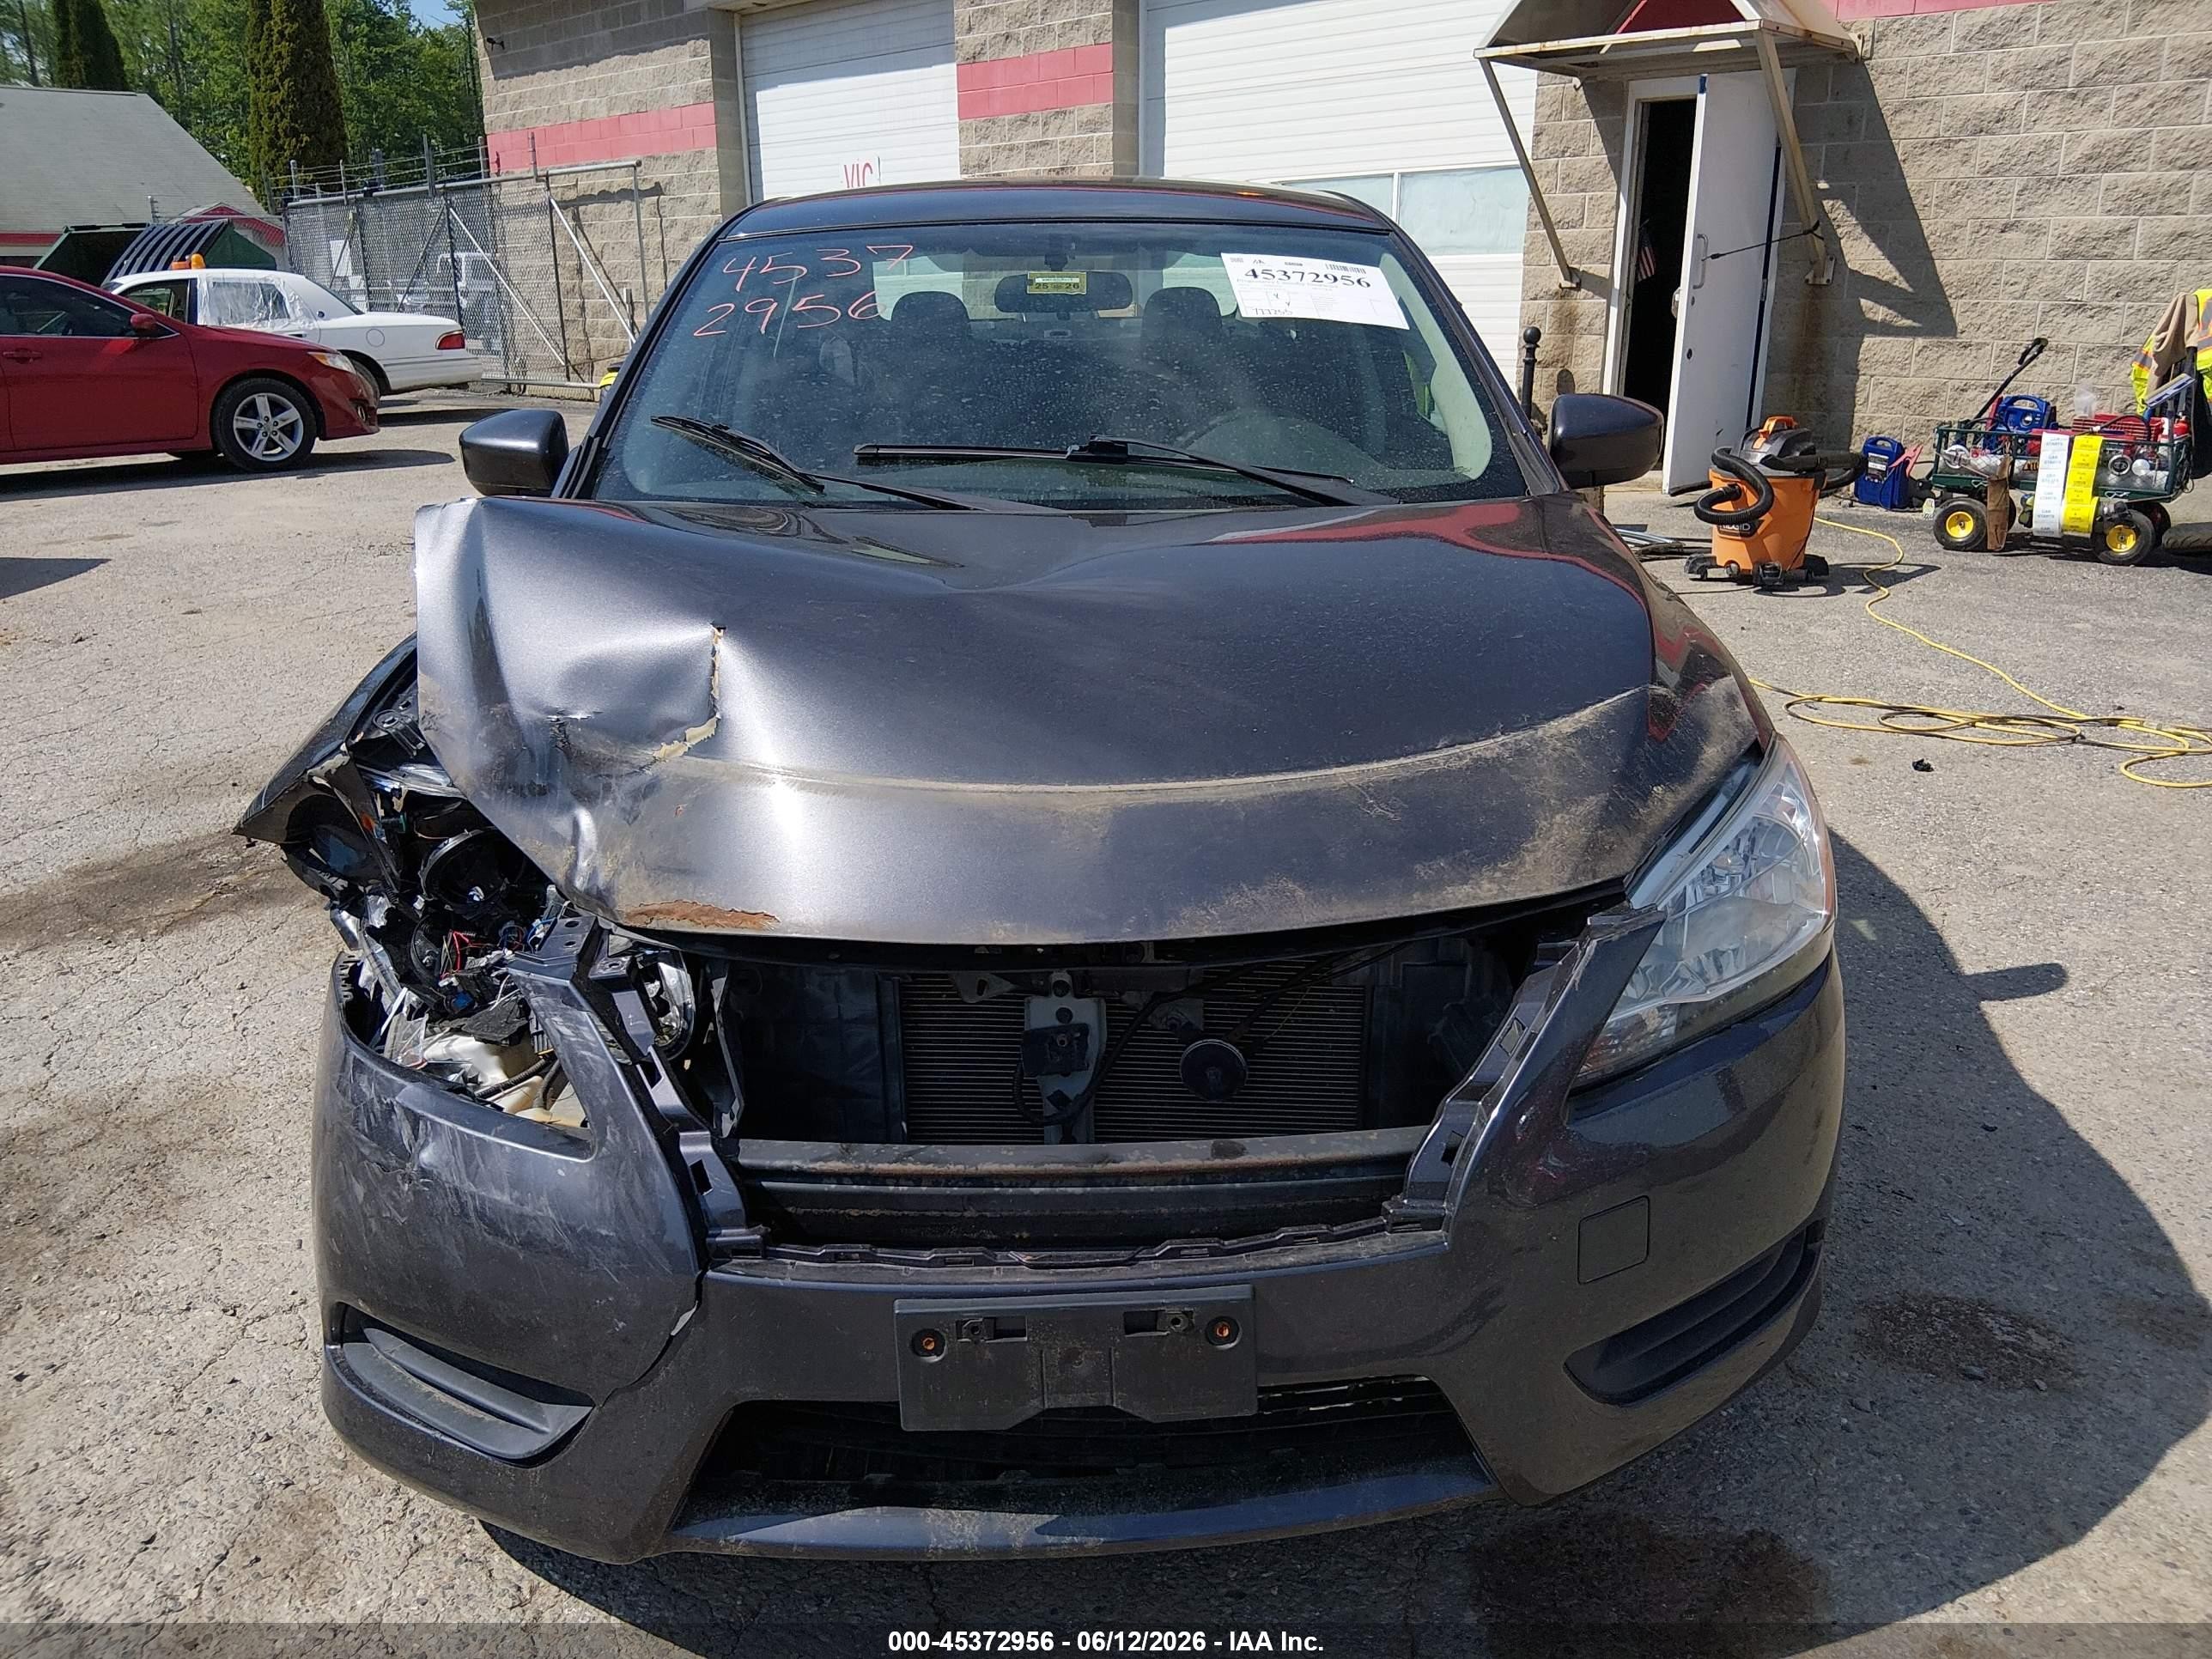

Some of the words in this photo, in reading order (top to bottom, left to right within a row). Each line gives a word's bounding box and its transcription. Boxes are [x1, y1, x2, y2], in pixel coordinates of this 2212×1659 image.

[723, 245, 914, 292] 4537
[1244, 268, 1371, 289] 45372956
[692, 290, 885, 337] 2956
